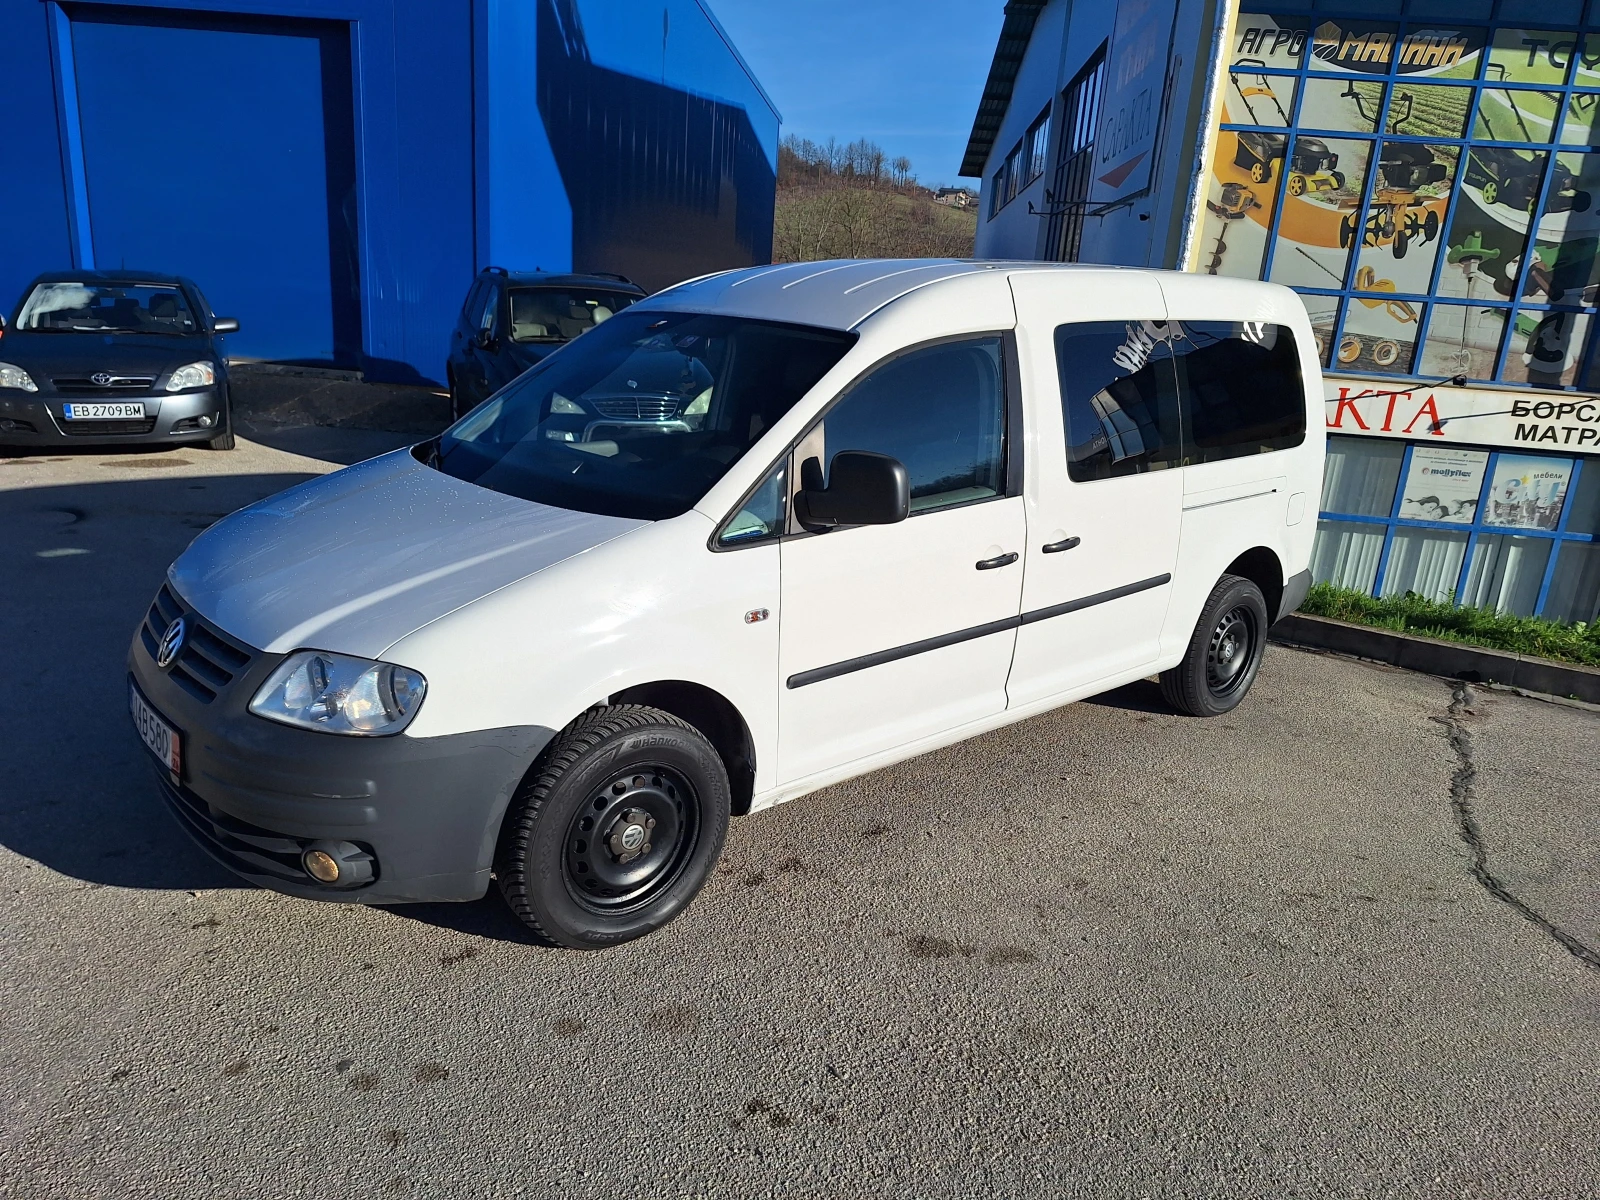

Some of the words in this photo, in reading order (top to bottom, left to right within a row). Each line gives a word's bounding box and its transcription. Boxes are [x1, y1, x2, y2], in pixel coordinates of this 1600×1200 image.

[1237, 27, 1308, 58] АГРО
[73, 405, 90, 417] EB
[92, 404, 122, 417] 2709
[124, 404, 142, 416] BM
[1326, 387, 1444, 436] КТА
[1430, 468, 1472, 478] mollyflex
[1533, 471, 1564, 480] мебели
